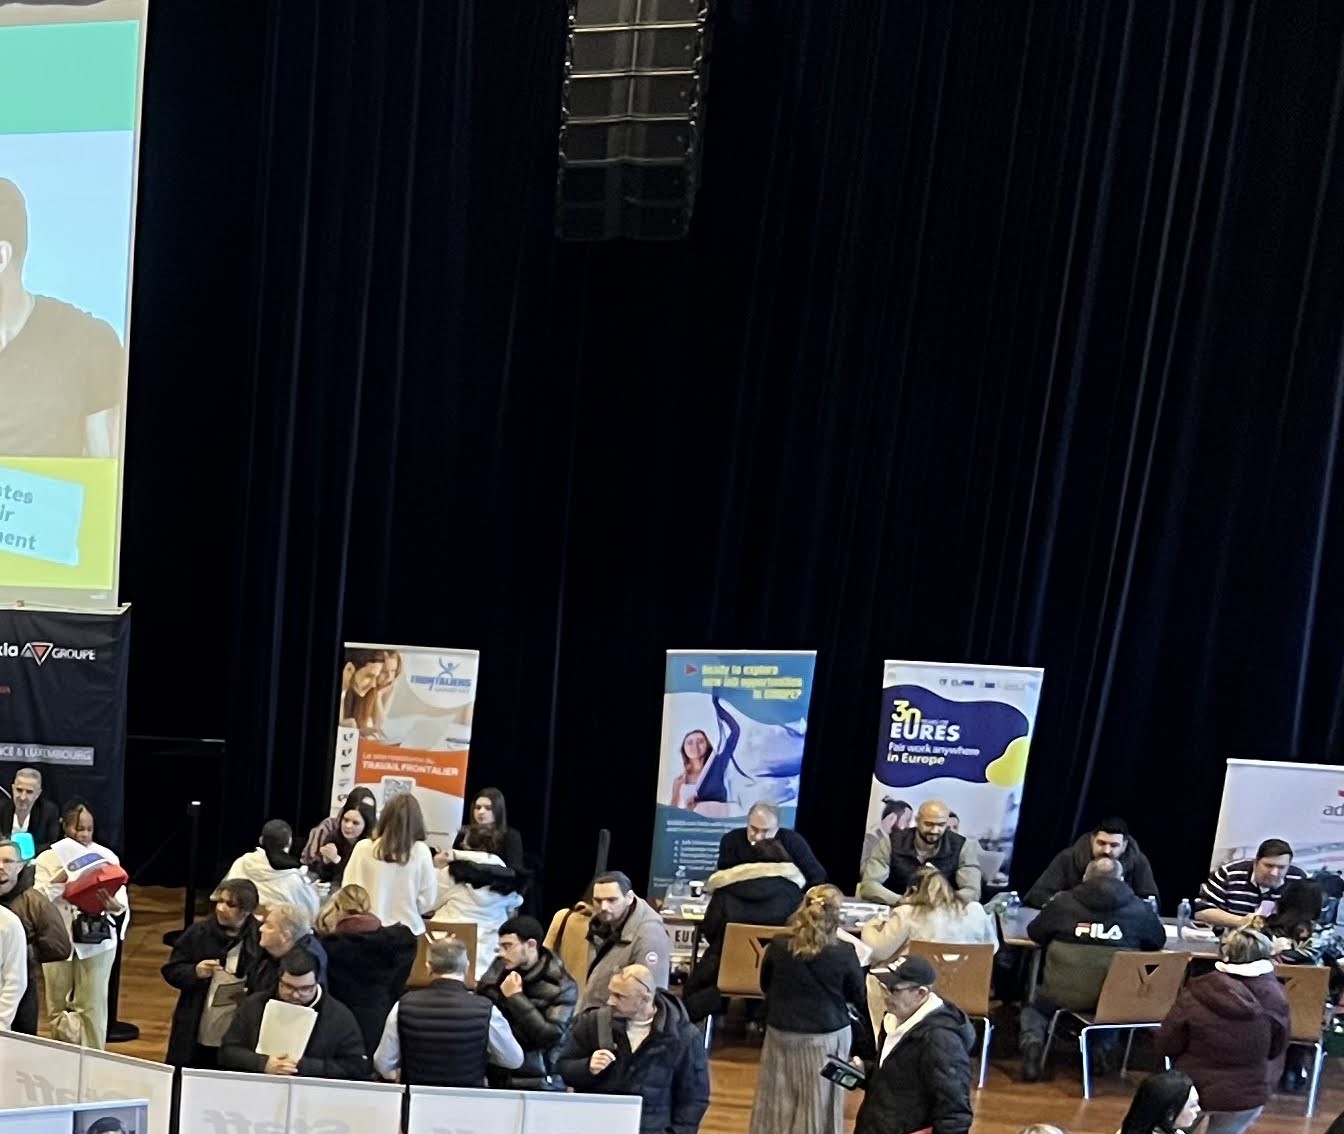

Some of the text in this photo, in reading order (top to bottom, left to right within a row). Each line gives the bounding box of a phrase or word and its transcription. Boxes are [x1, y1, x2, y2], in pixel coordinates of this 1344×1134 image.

[51, 648, 96, 660] GROUPE
[890, 722, 960, 742] EURES
[25, 747, 92, 761] LUXEMBOURG
[887, 752, 945, 765] in Europe
[362, 760, 459, 776] TRAVAIL FRONTALIER
[1075, 921, 1123, 941] FILA
